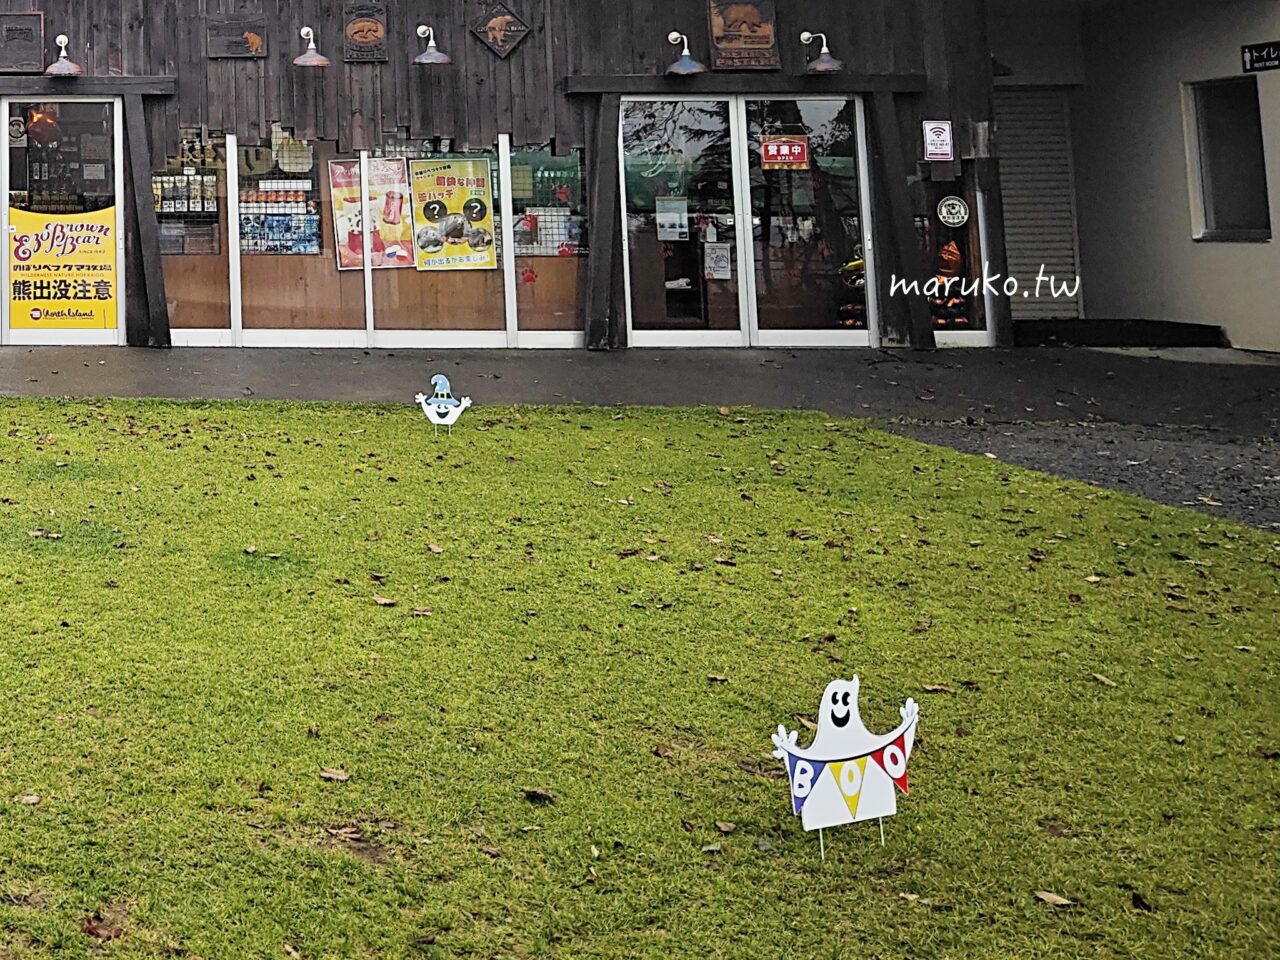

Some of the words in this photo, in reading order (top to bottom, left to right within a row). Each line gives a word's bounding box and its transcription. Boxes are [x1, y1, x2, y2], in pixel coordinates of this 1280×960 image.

[768, 145, 801, 156] 営業中
[429, 204, 440, 219] ?
[470, 203, 480, 218] ?
[12, 280, 112, 301] 熊出没注意
[43, 308, 68, 317] North
[68, 308, 95, 317] Island
[793, 744, 906, 799] BOO
